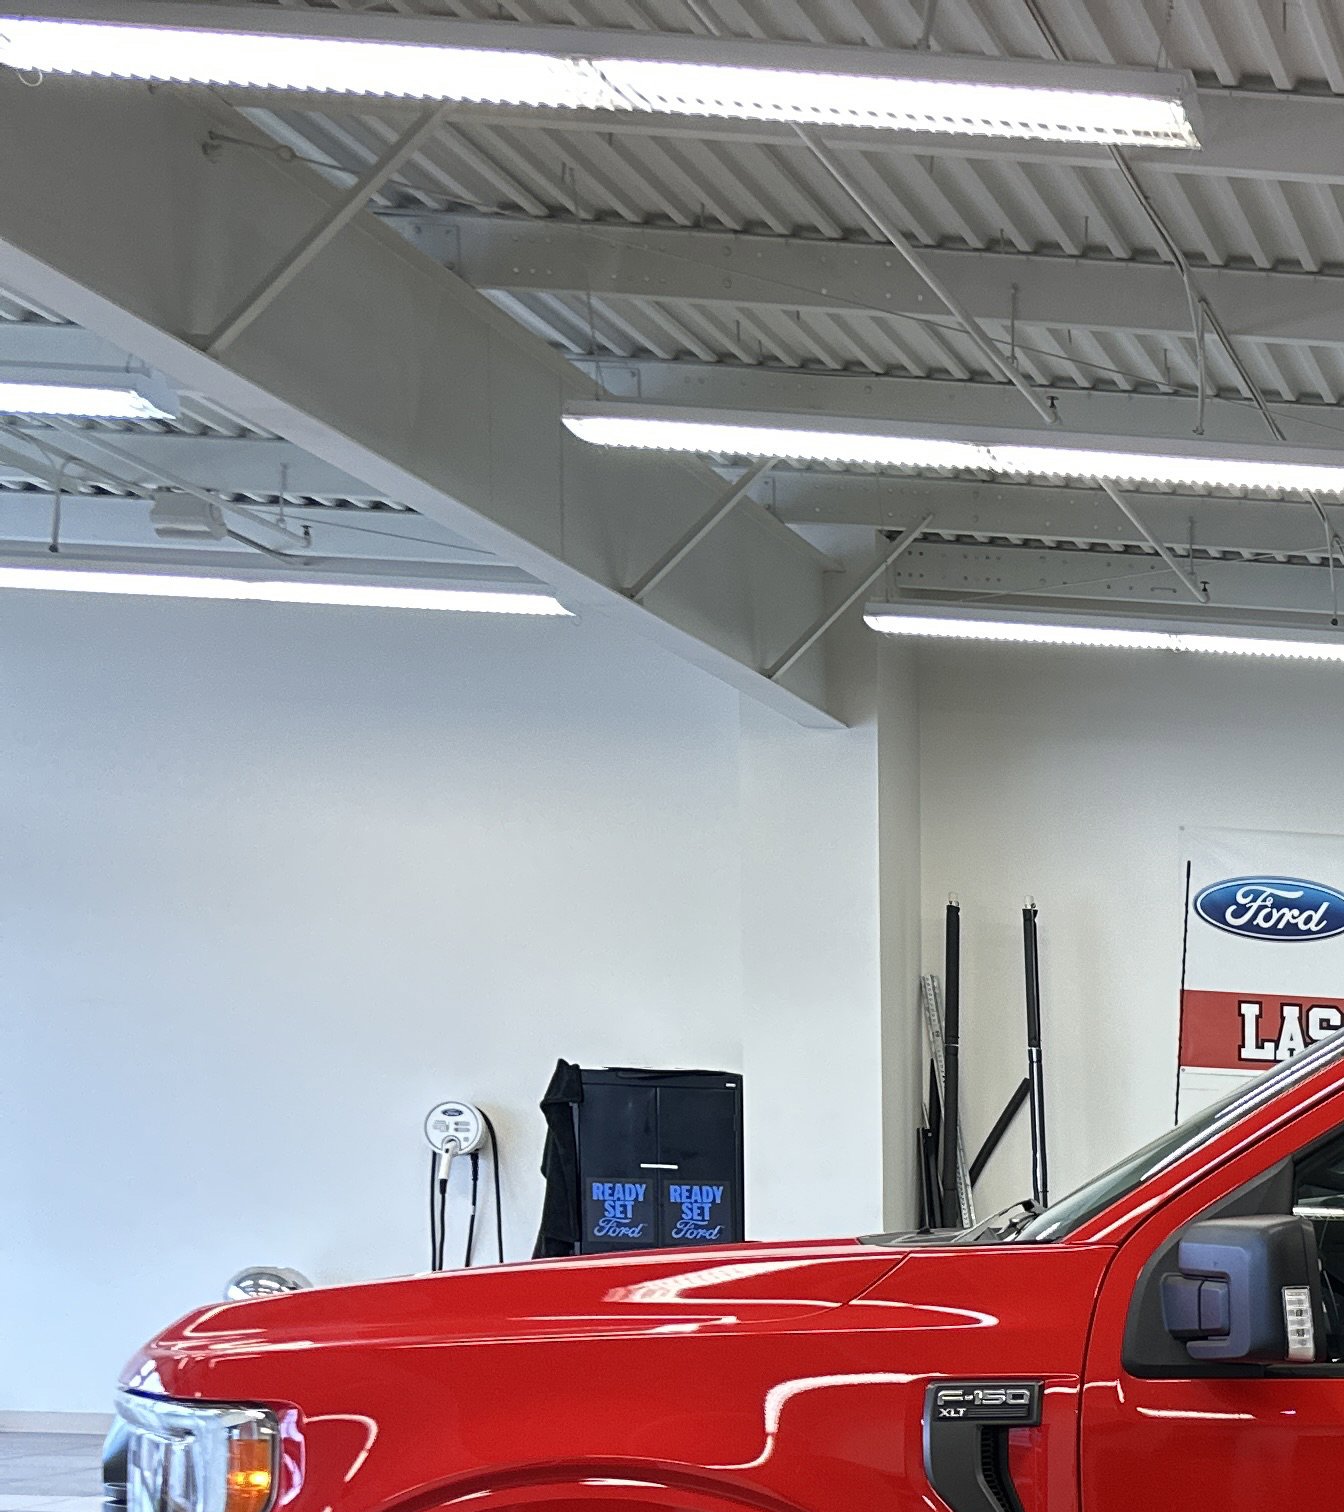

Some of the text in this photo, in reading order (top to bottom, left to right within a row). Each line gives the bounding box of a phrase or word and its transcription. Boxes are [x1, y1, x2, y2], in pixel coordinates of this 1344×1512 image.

[1225, 885, 1330, 932] Ford
[591, 1182, 647, 1202] READY
[669, 1184, 724, 1204] READY
[604, 1201, 635, 1219] SET
[681, 1203, 712, 1220] SET
[593, 1217, 644, 1238] Ford
[671, 1219, 721, 1240] Ford
[937, 1388, 1030, 1406] F-150
[938, 1408, 967, 1418] XLT
